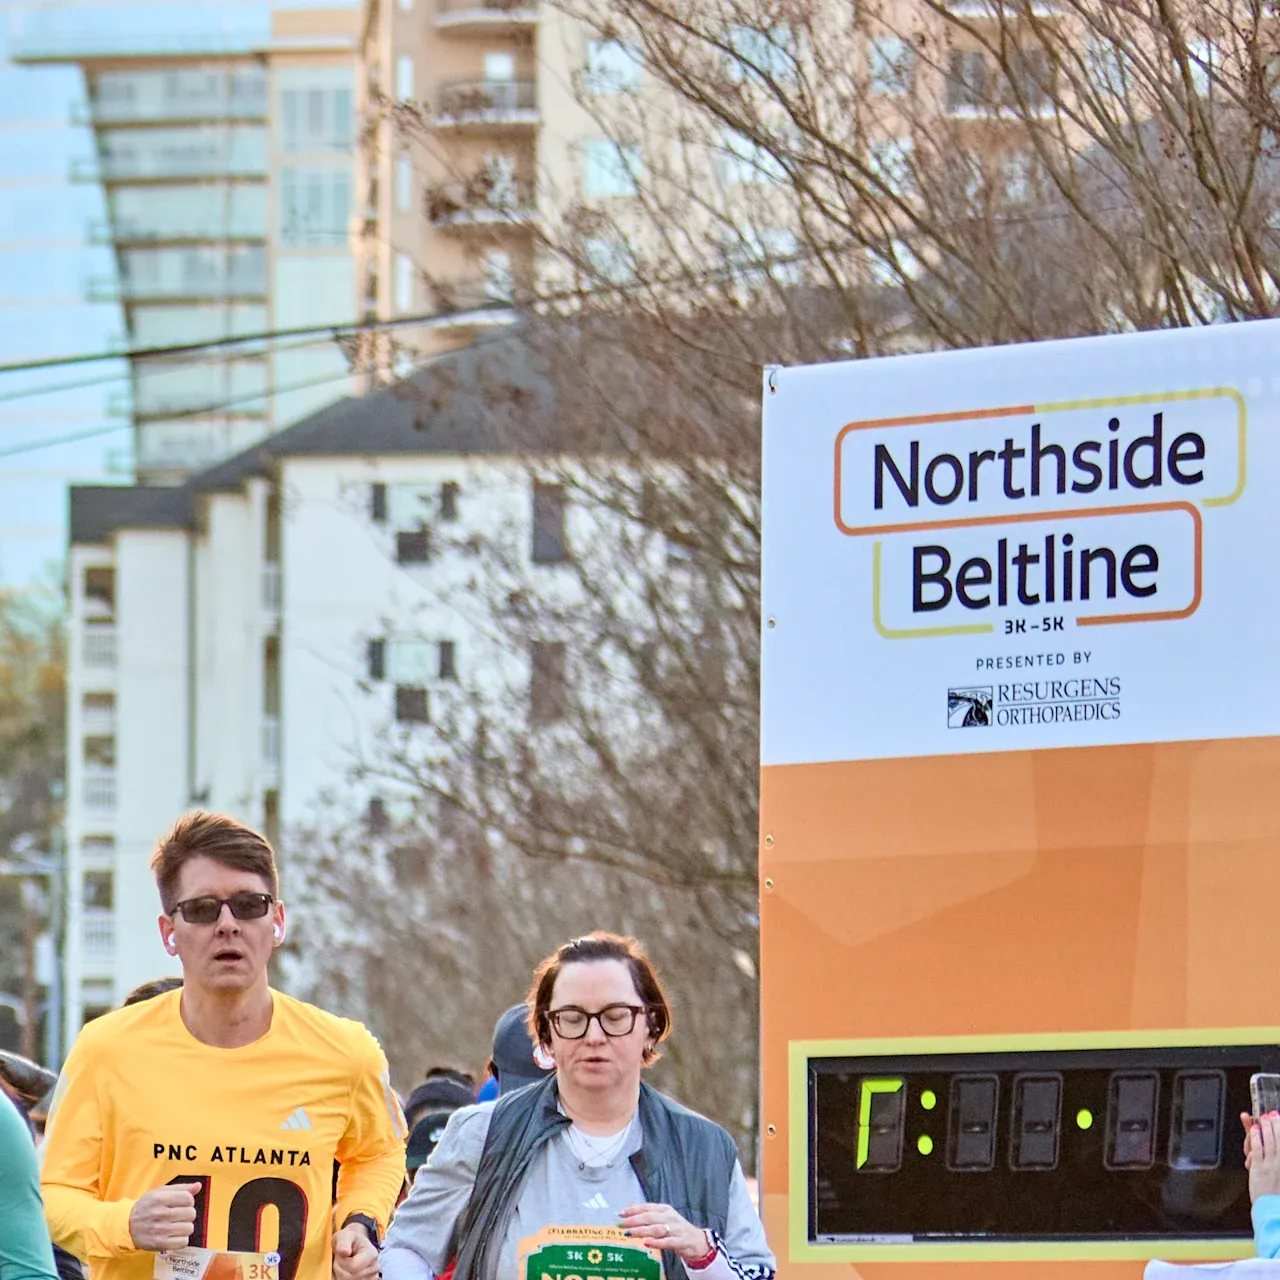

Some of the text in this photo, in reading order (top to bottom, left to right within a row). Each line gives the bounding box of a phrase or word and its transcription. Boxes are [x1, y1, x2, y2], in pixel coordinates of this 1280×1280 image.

[873, 411, 1206, 510] Northside
[912, 533, 1160, 614] Beltline
[975, 651, 1093, 671] PRESENTED BY
[996, 676, 1122, 701] RESURGENS
[996, 702, 1122, 727] ORTHOPAEDICS
[153, 1143, 311, 1167] PNC ATLANTA
[547, 1227, 603, 1237] CELEBRATING
[169, 1256, 201, 1267] Northside
[566, 1250, 584, 1260] 3K
[607, 1252, 624, 1263] 5K
[172, 1265, 196, 1275] Beltline
[248, 1264, 273, 1280] 3K
